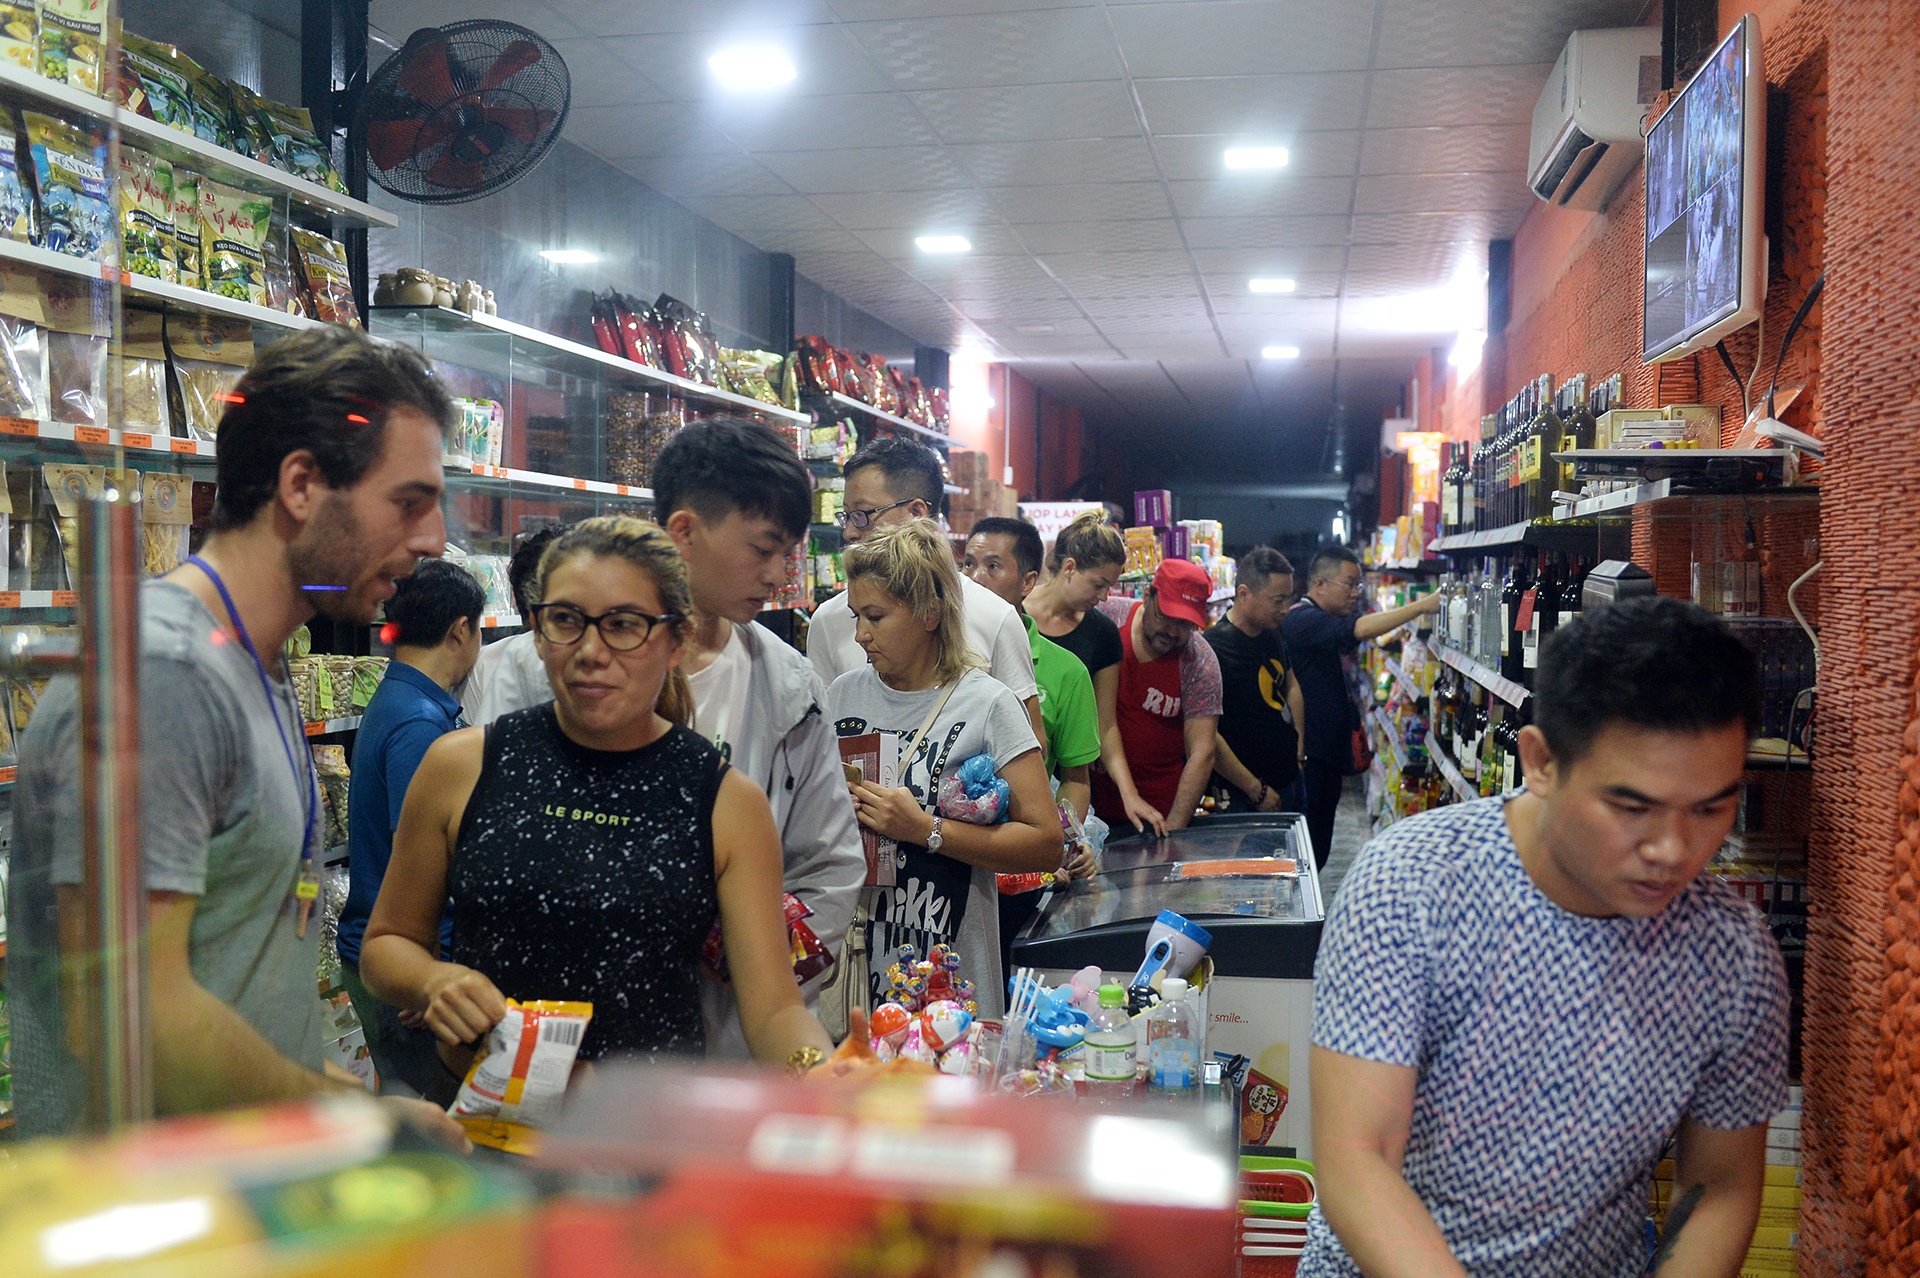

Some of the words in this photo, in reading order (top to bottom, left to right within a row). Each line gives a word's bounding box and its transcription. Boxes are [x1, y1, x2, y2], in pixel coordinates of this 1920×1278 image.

[545, 804, 567, 817] LE
[571, 808, 631, 827] SPORT
[1215, 1012, 1249, 1024] smile...
